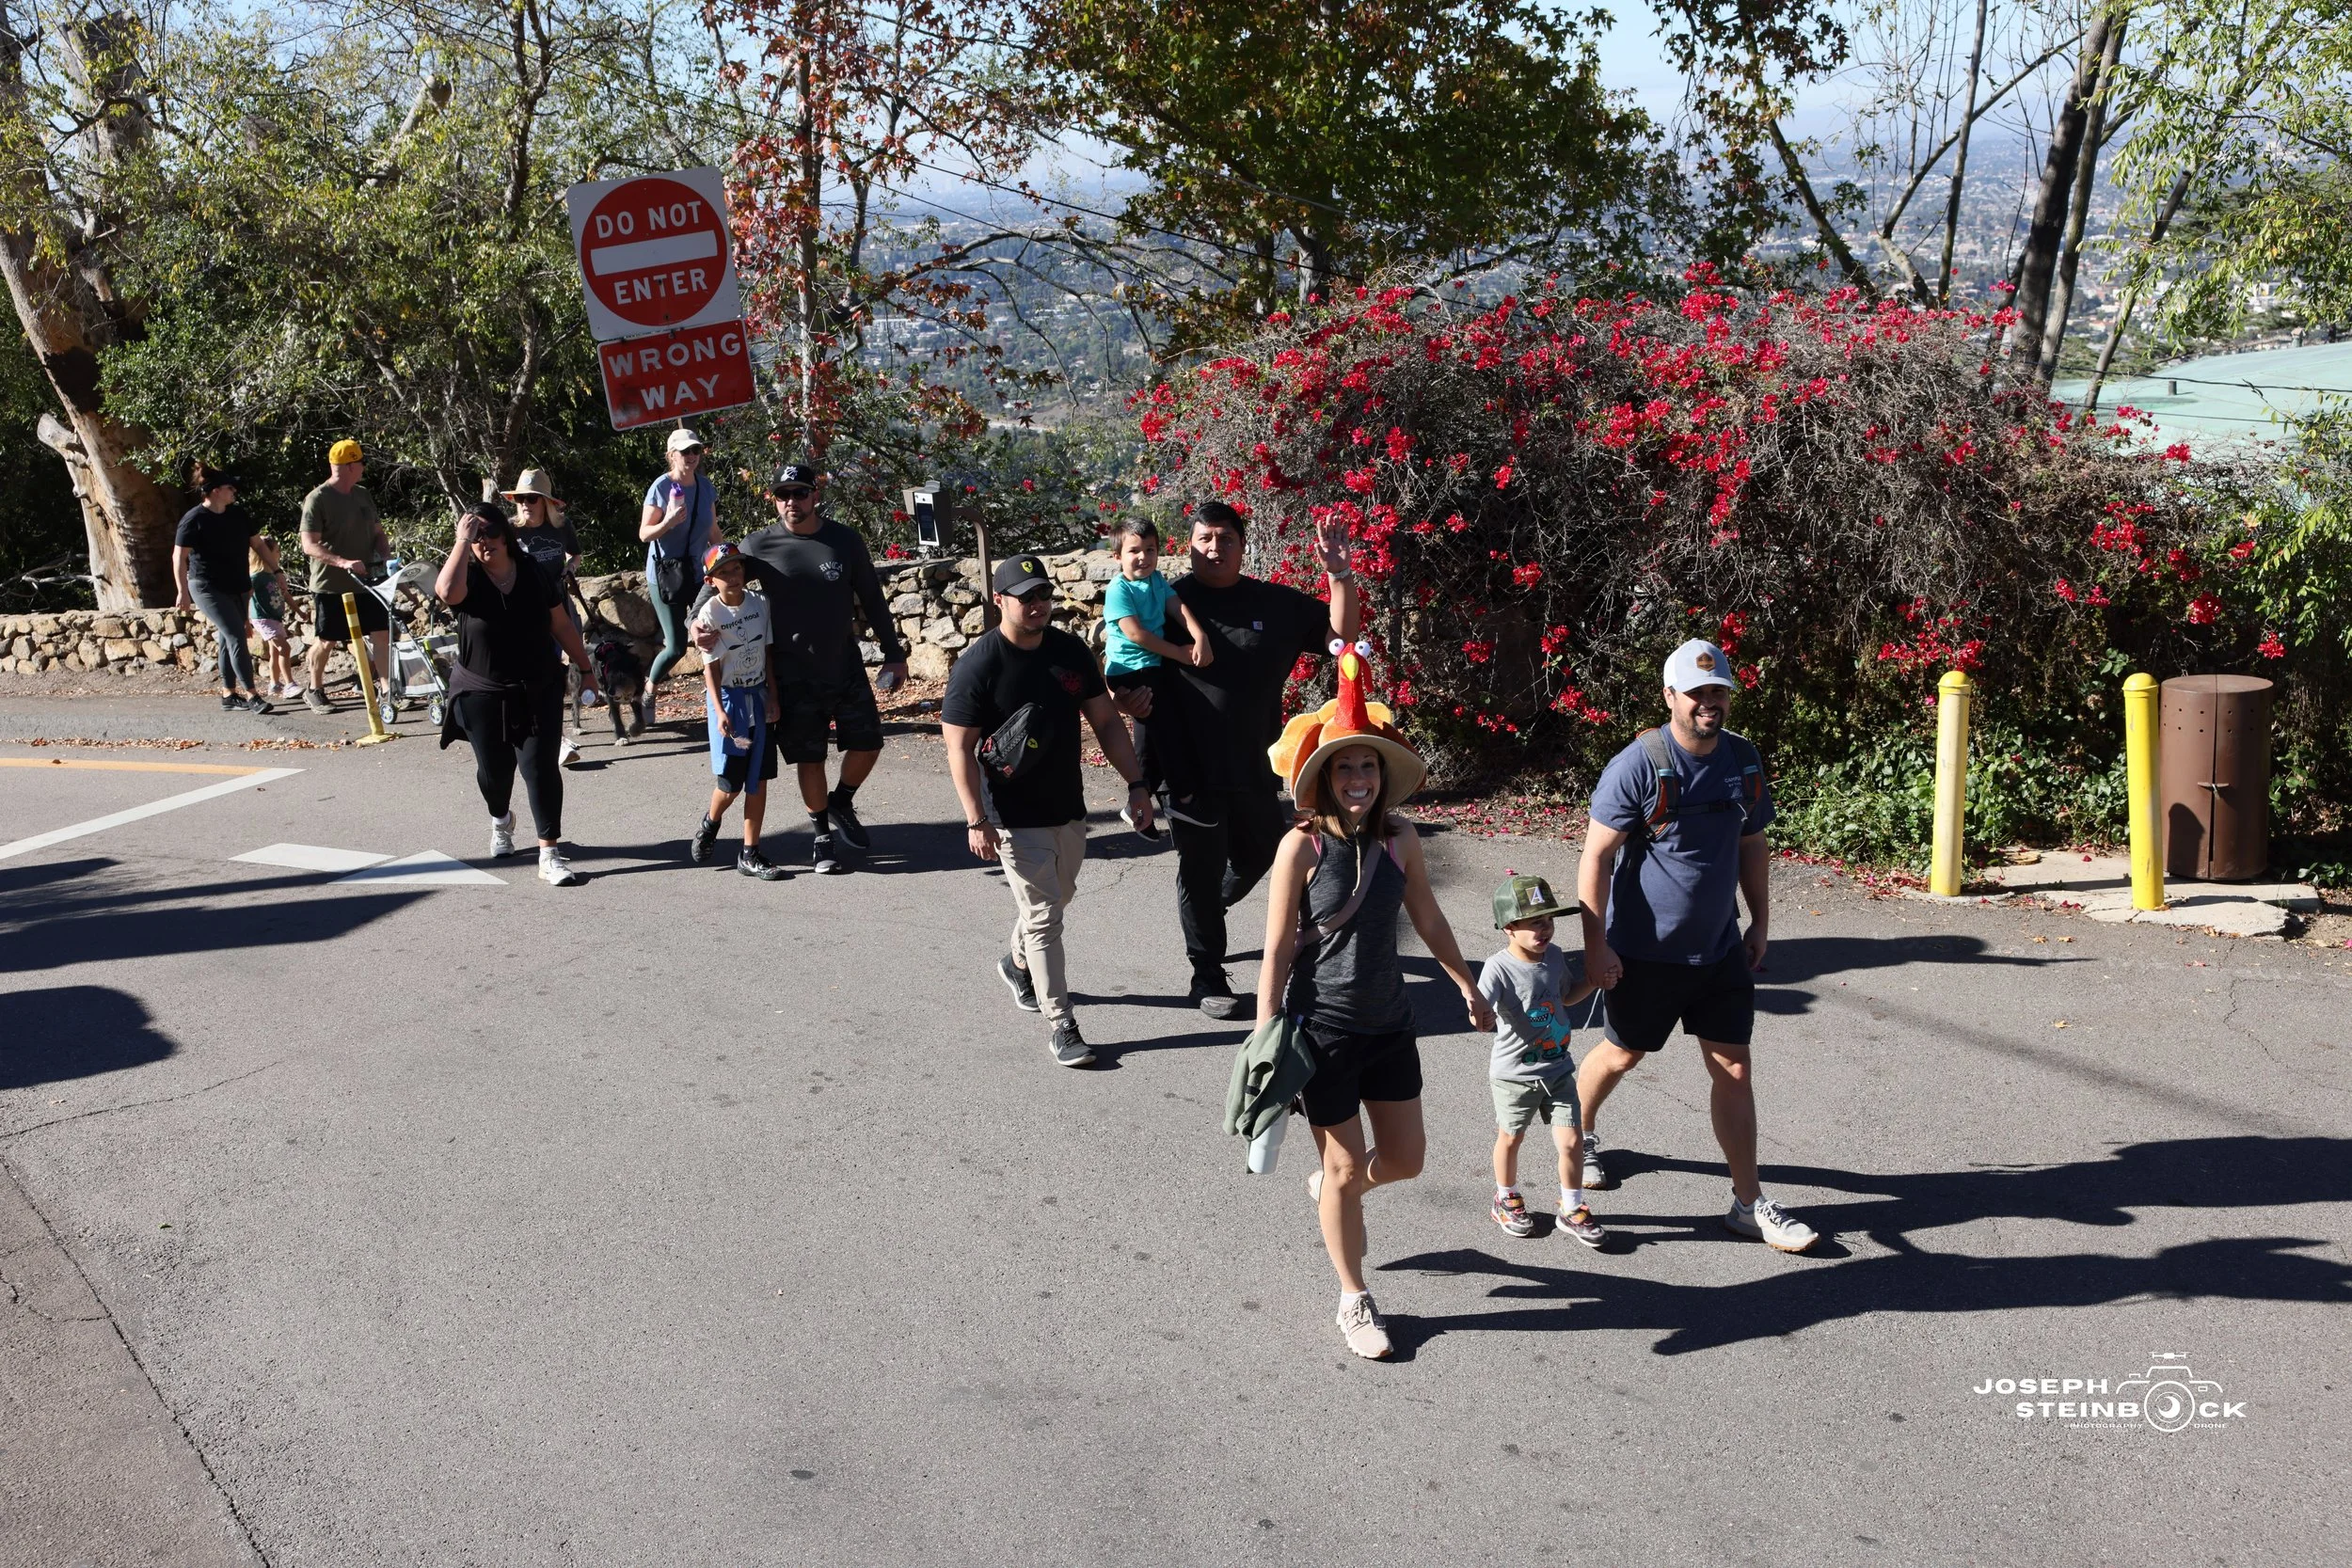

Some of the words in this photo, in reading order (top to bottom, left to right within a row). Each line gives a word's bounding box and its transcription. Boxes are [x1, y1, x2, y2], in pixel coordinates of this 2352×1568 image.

[596, 211, 634, 239] DO
[647, 200, 702, 230] NOT
[613, 268, 707, 305] ENTER
[608, 332, 741, 378] WRONG
[640, 373, 720, 410] WAY
[721, 618, 743, 630] DEPECHE
[743, 611, 760, 622] MODE
[1531, 885, 1545, 905] A
